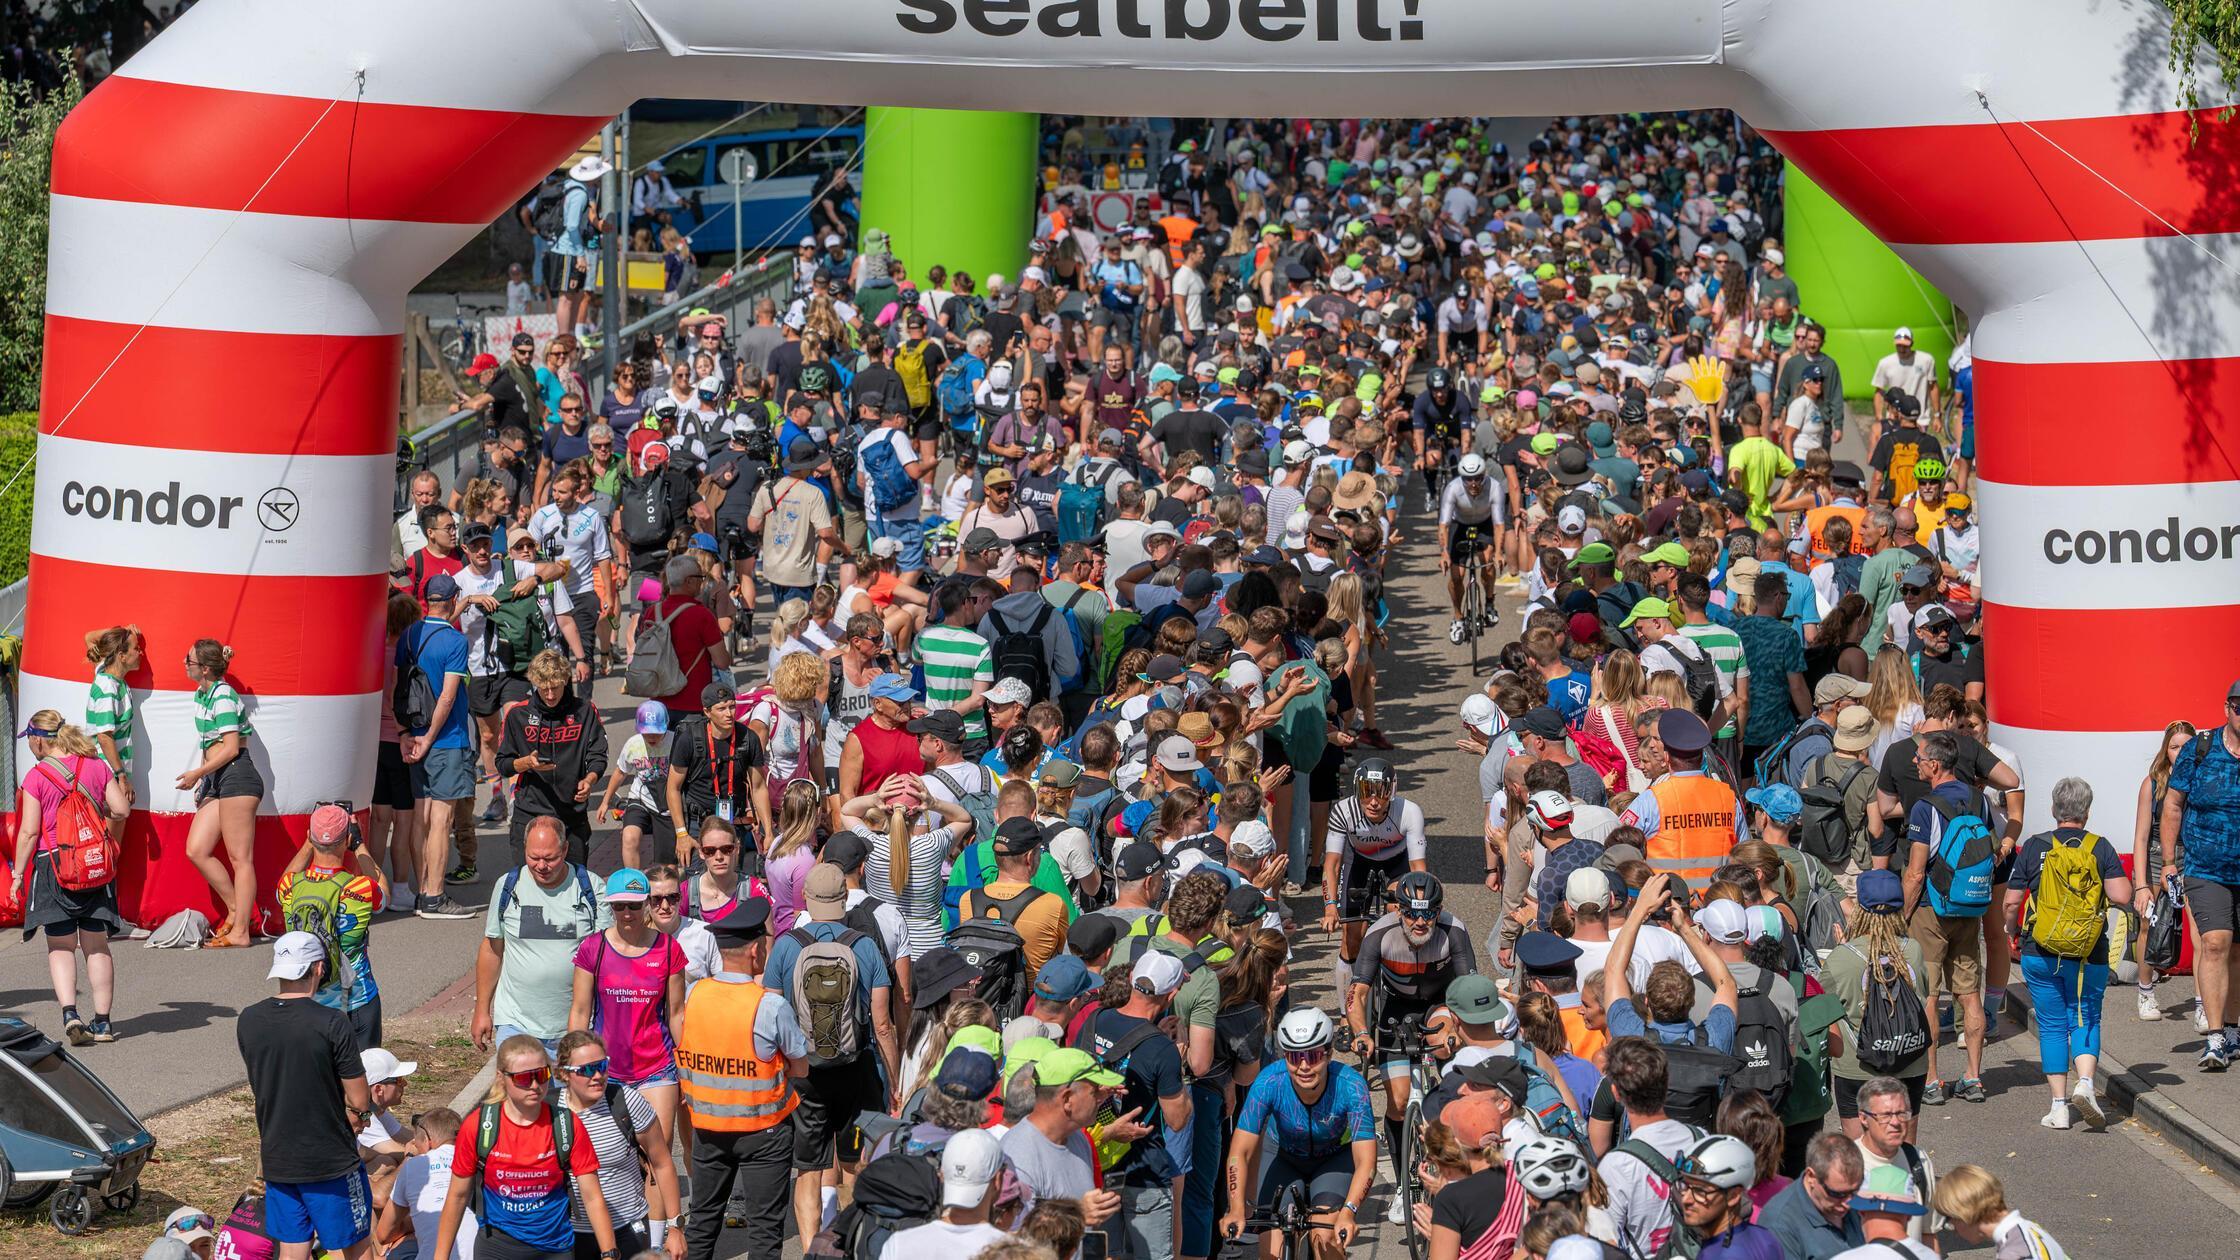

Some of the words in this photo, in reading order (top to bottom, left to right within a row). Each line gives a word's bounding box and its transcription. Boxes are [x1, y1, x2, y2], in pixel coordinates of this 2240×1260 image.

[62, 481, 243, 529] condor
[2043, 516, 2240, 565] condor
[1664, 812, 1733, 830] FEUERWEHR
[605, 987, 638, 997] Triathlon
[640, 988, 659, 997] Team
[616, 995, 650, 1004] Lüneburg
[1871, 1028, 1926, 1055] sailfish
[677, 1050, 758, 1078] FEUERWEHR
